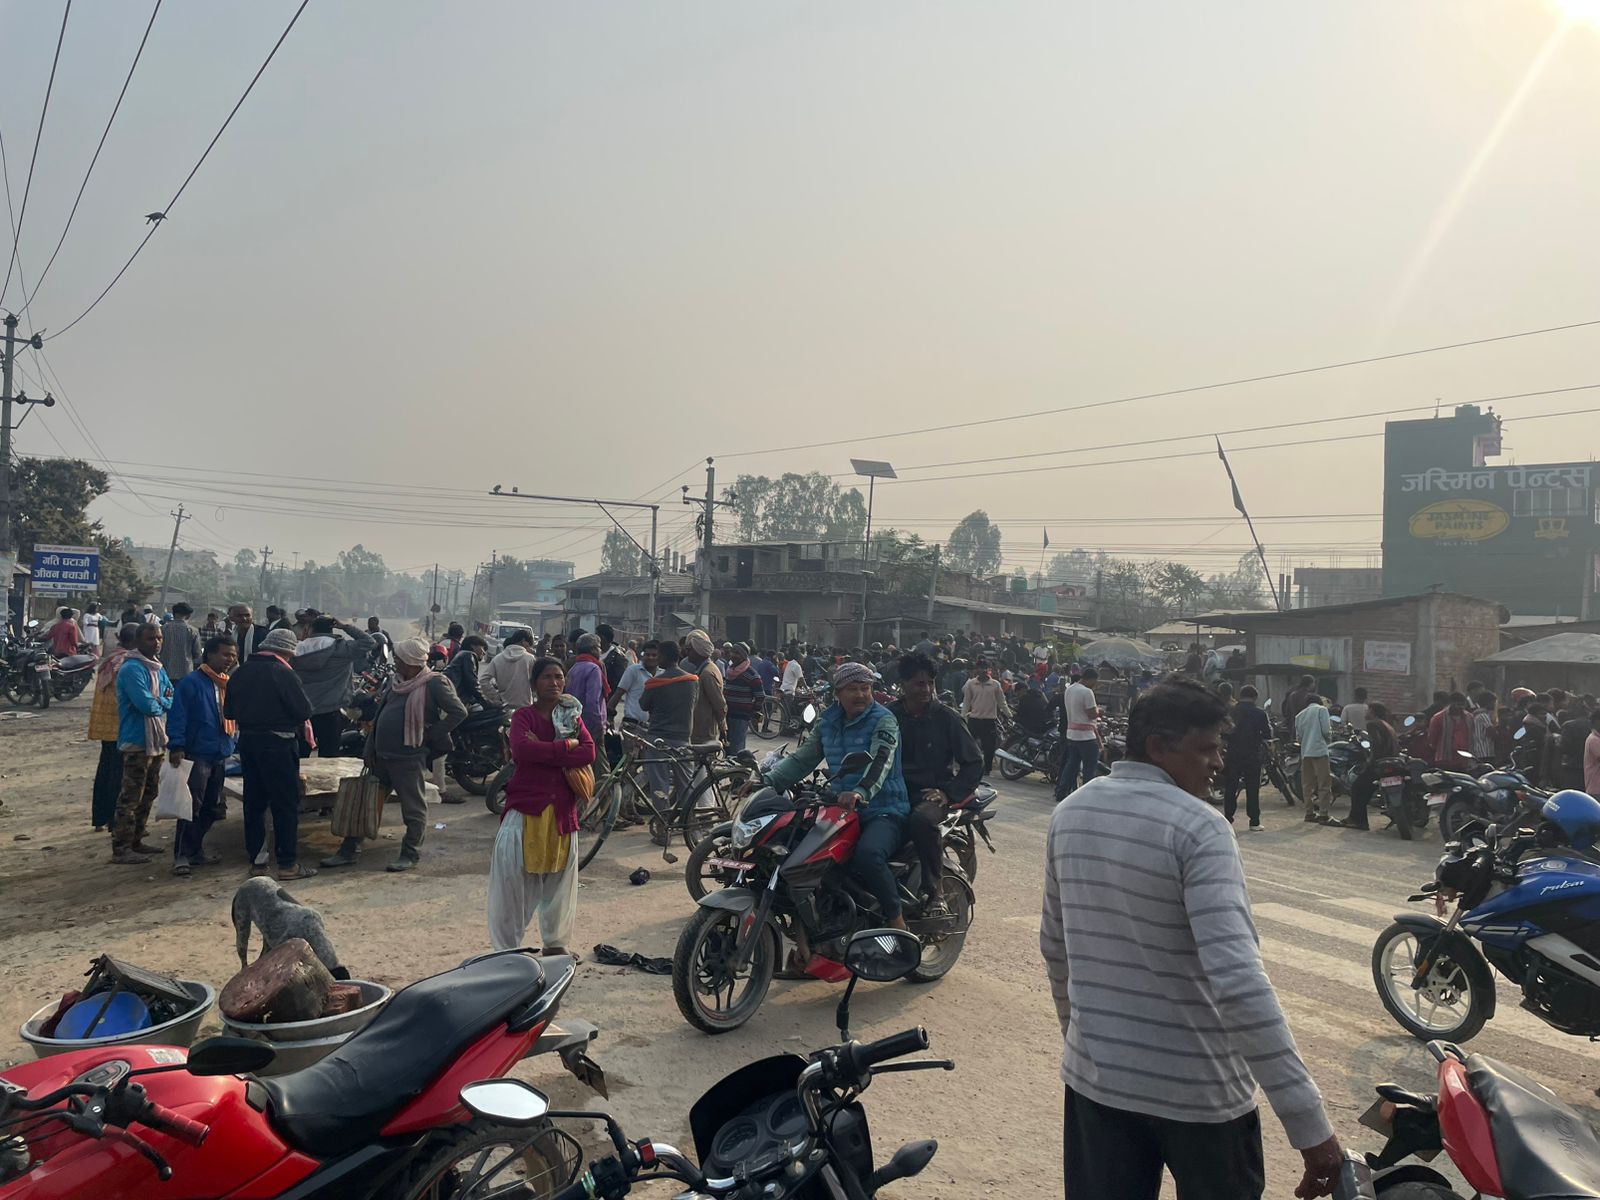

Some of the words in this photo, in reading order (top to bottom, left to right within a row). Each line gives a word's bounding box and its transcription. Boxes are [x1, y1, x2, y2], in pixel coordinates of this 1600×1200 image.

[1435, 521, 1484, 530] PAINTS
[42, 555, 60, 566] गति
[62, 556, 90, 567] घटाओ
[34, 568, 60, 579] जीवन
[62, 569, 90, 580] बचाओ
